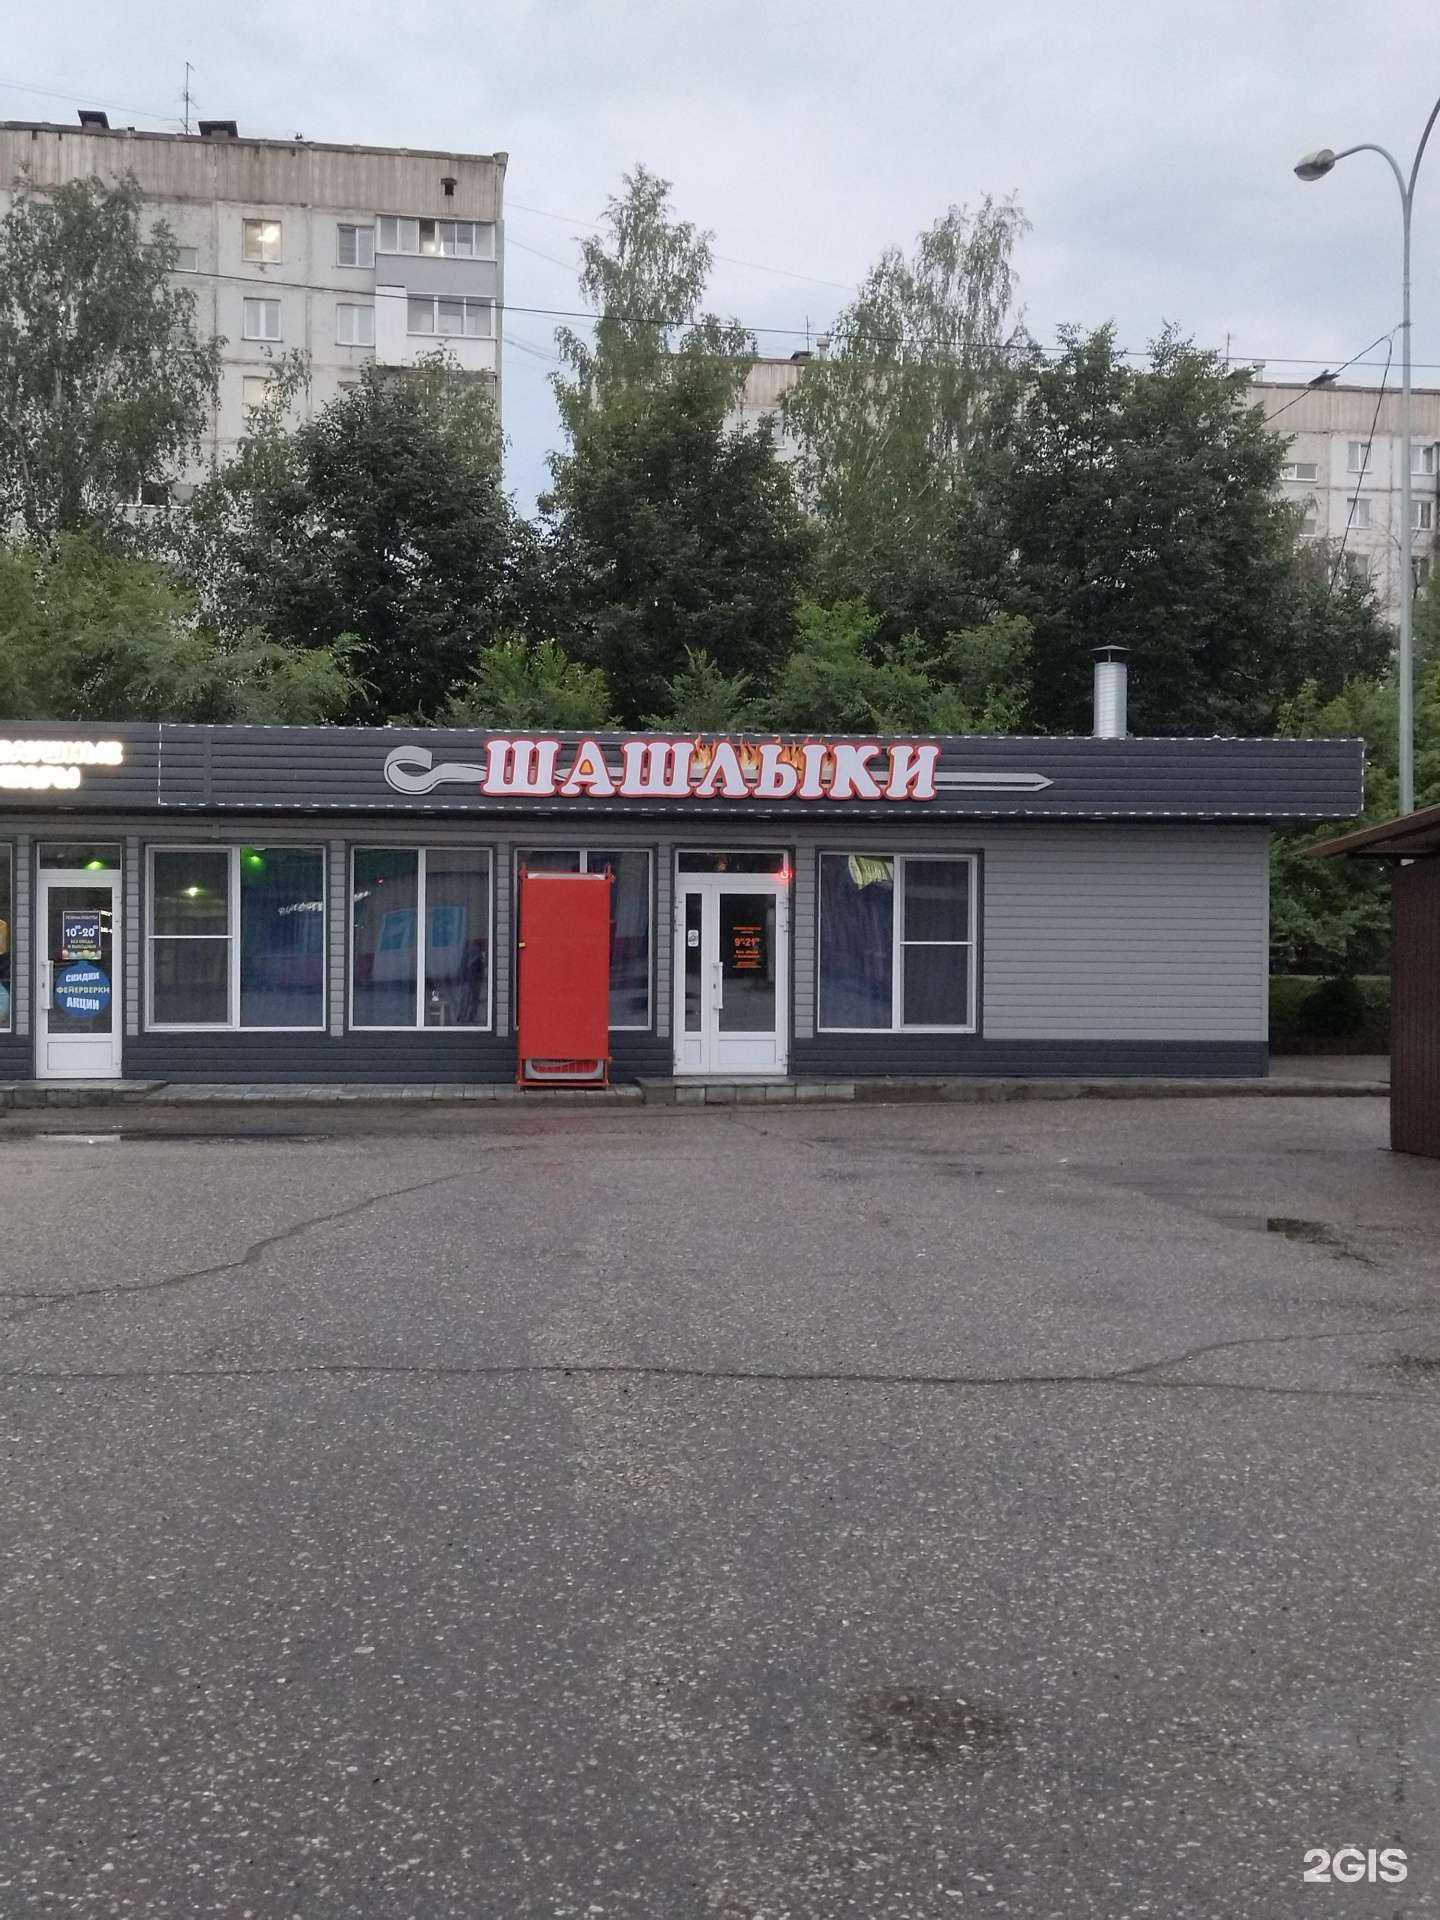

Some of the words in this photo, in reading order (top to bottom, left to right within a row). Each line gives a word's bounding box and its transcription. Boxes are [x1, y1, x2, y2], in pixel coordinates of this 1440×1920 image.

[481, 739, 941, 799] ШАШЛЫКИ
[65, 972, 100, 982] СКИДКИ
[66, 997, 100, 1010] АКЦИИ
